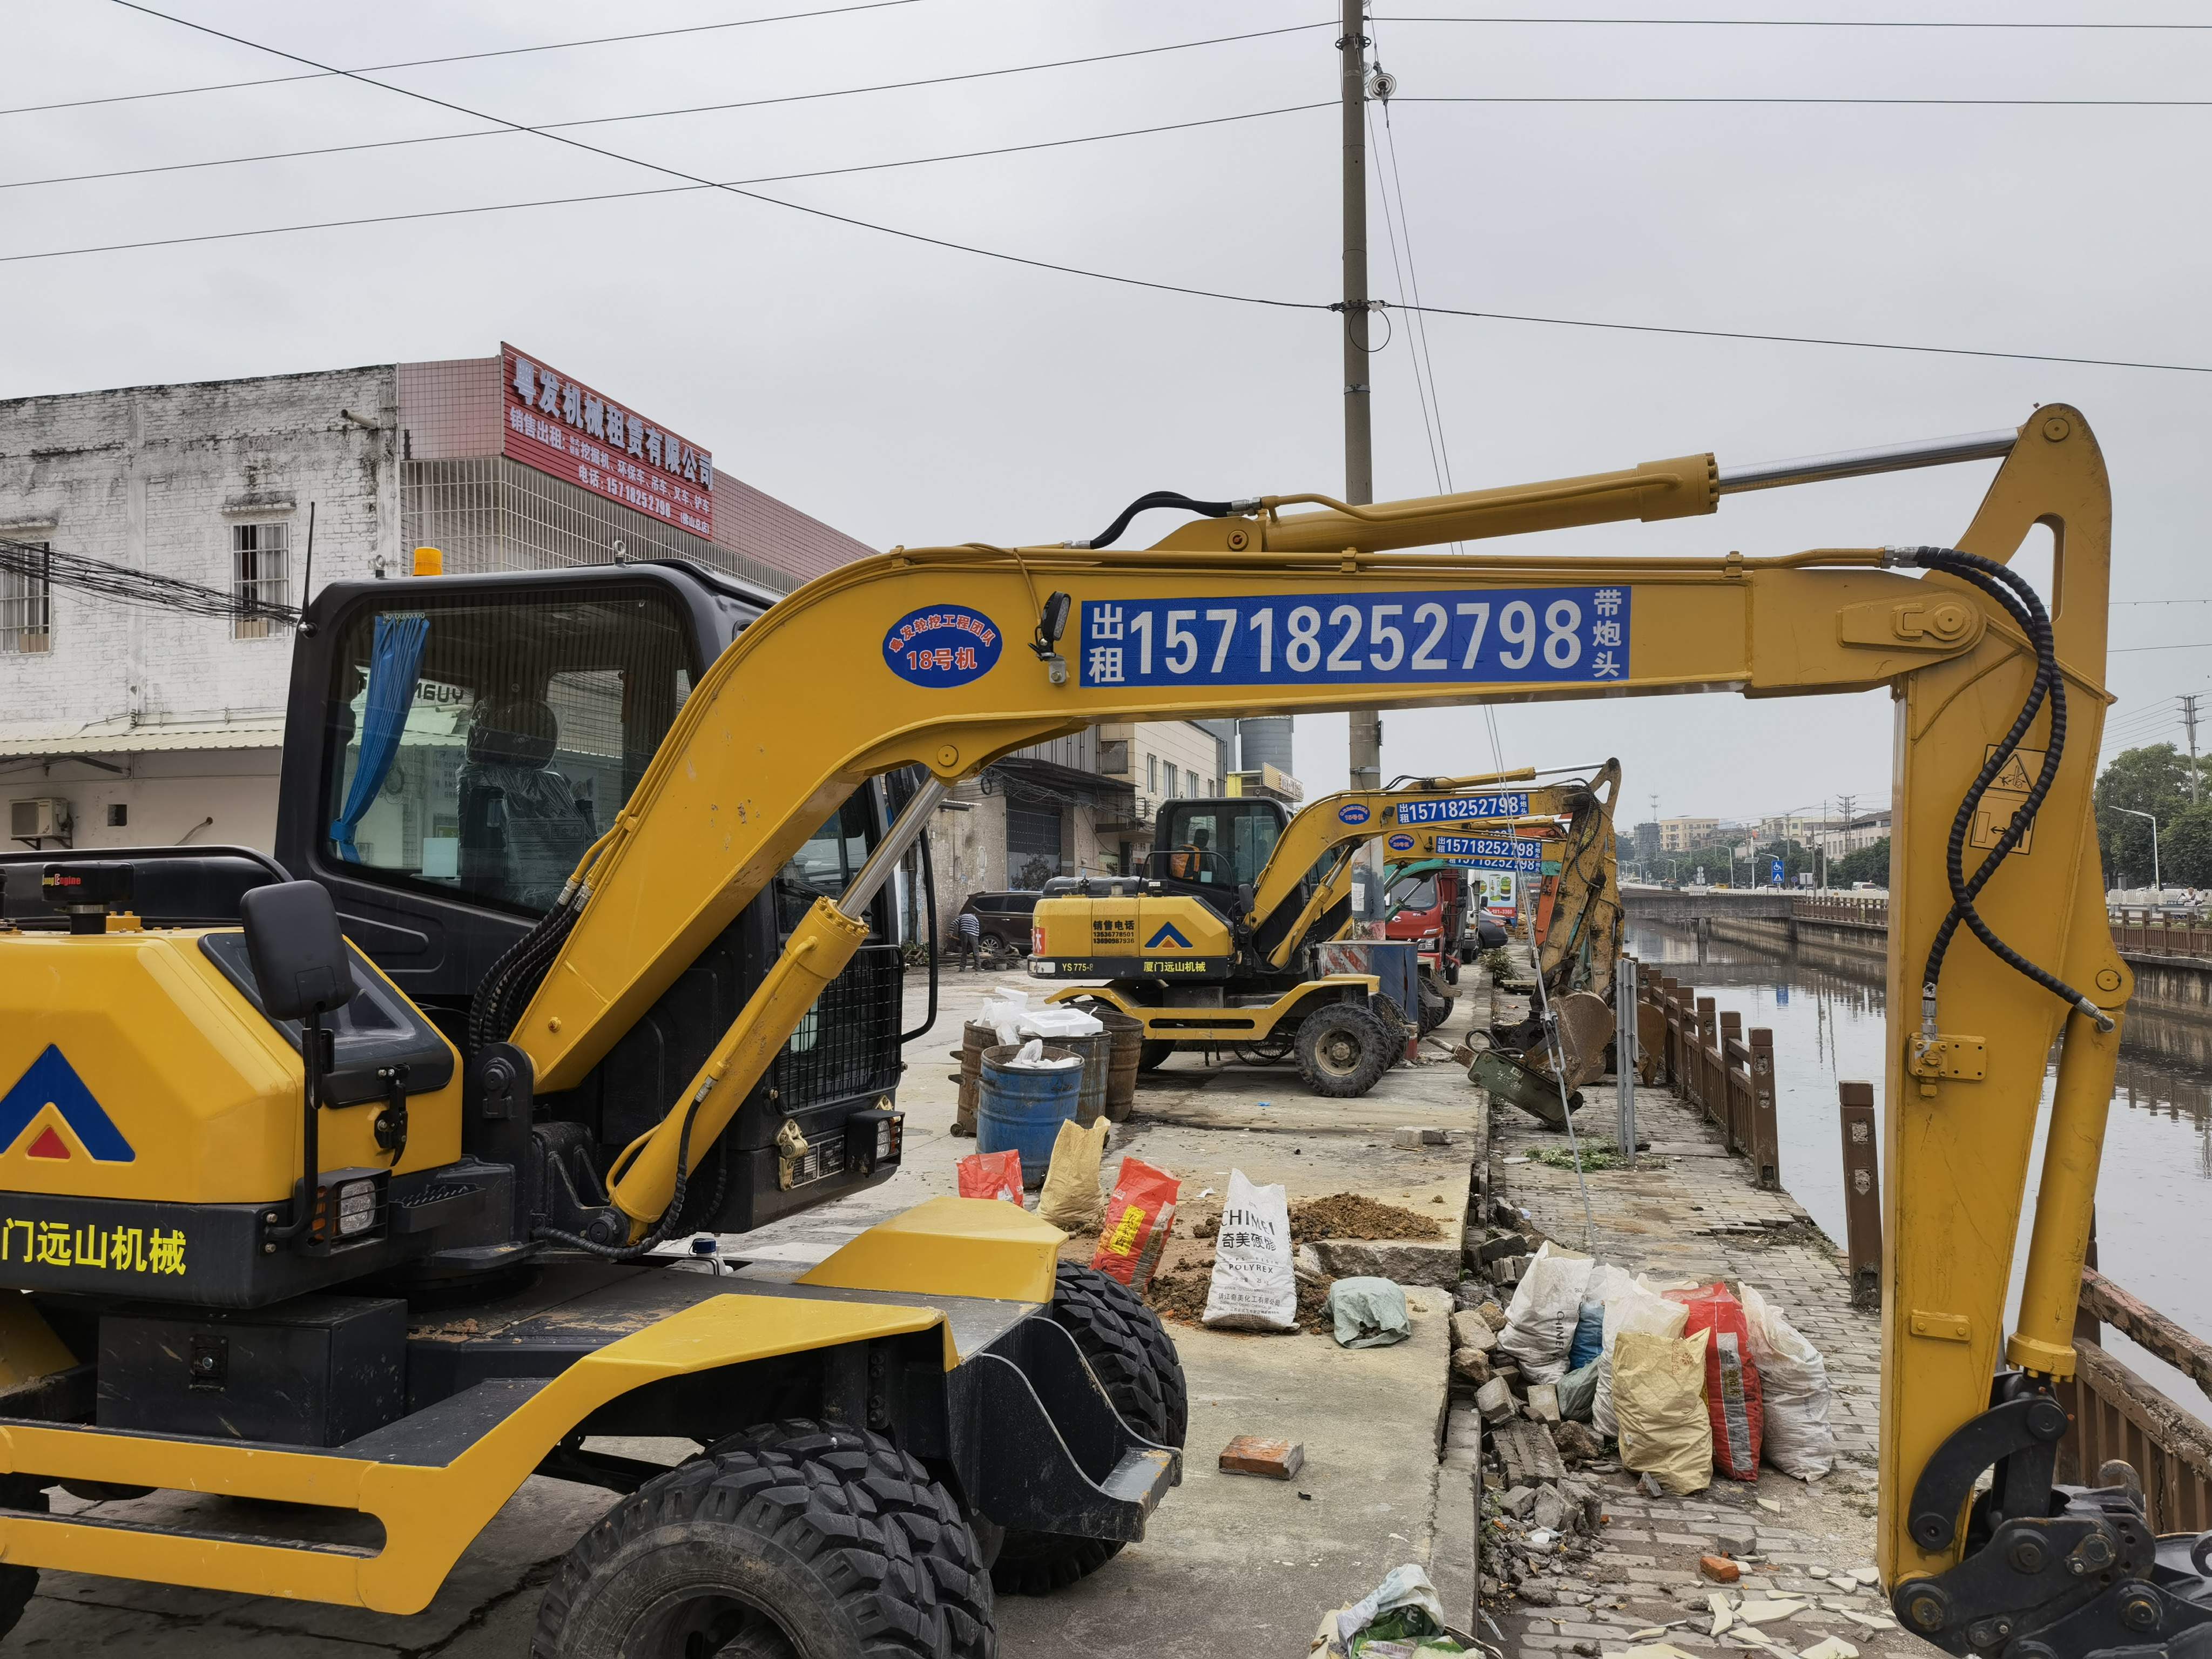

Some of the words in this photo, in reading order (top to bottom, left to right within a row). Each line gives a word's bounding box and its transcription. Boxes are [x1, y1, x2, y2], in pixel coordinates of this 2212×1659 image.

[514, 358, 713, 490] 粤发机械租赁有限公司
[889, 614, 996, 653] 粤发轮挖工程团队
[1088, 603, 1125, 683] 出租
[1129, 599, 1582, 674] 15718252798
[1592, 589, 1622, 678] 带炮头
[907, 647, 977, 671] 18号机
[1399, 803, 1410, 824] 出租
[1410, 797, 1519, 821] 15718252798
[1437, 837, 1446, 853] 出租
[1093, 920, 1135, 930] 销售电话
[1062, 963, 1073, 972] YS
[1143, 961, 1206, 973] 厦门远山机械
[1222, 1209, 1275, 1236] CHIMEI
[1229, 1264, 1273, 1274] POLYREX
[1555, 1310, 1565, 1351] CHIMEI
